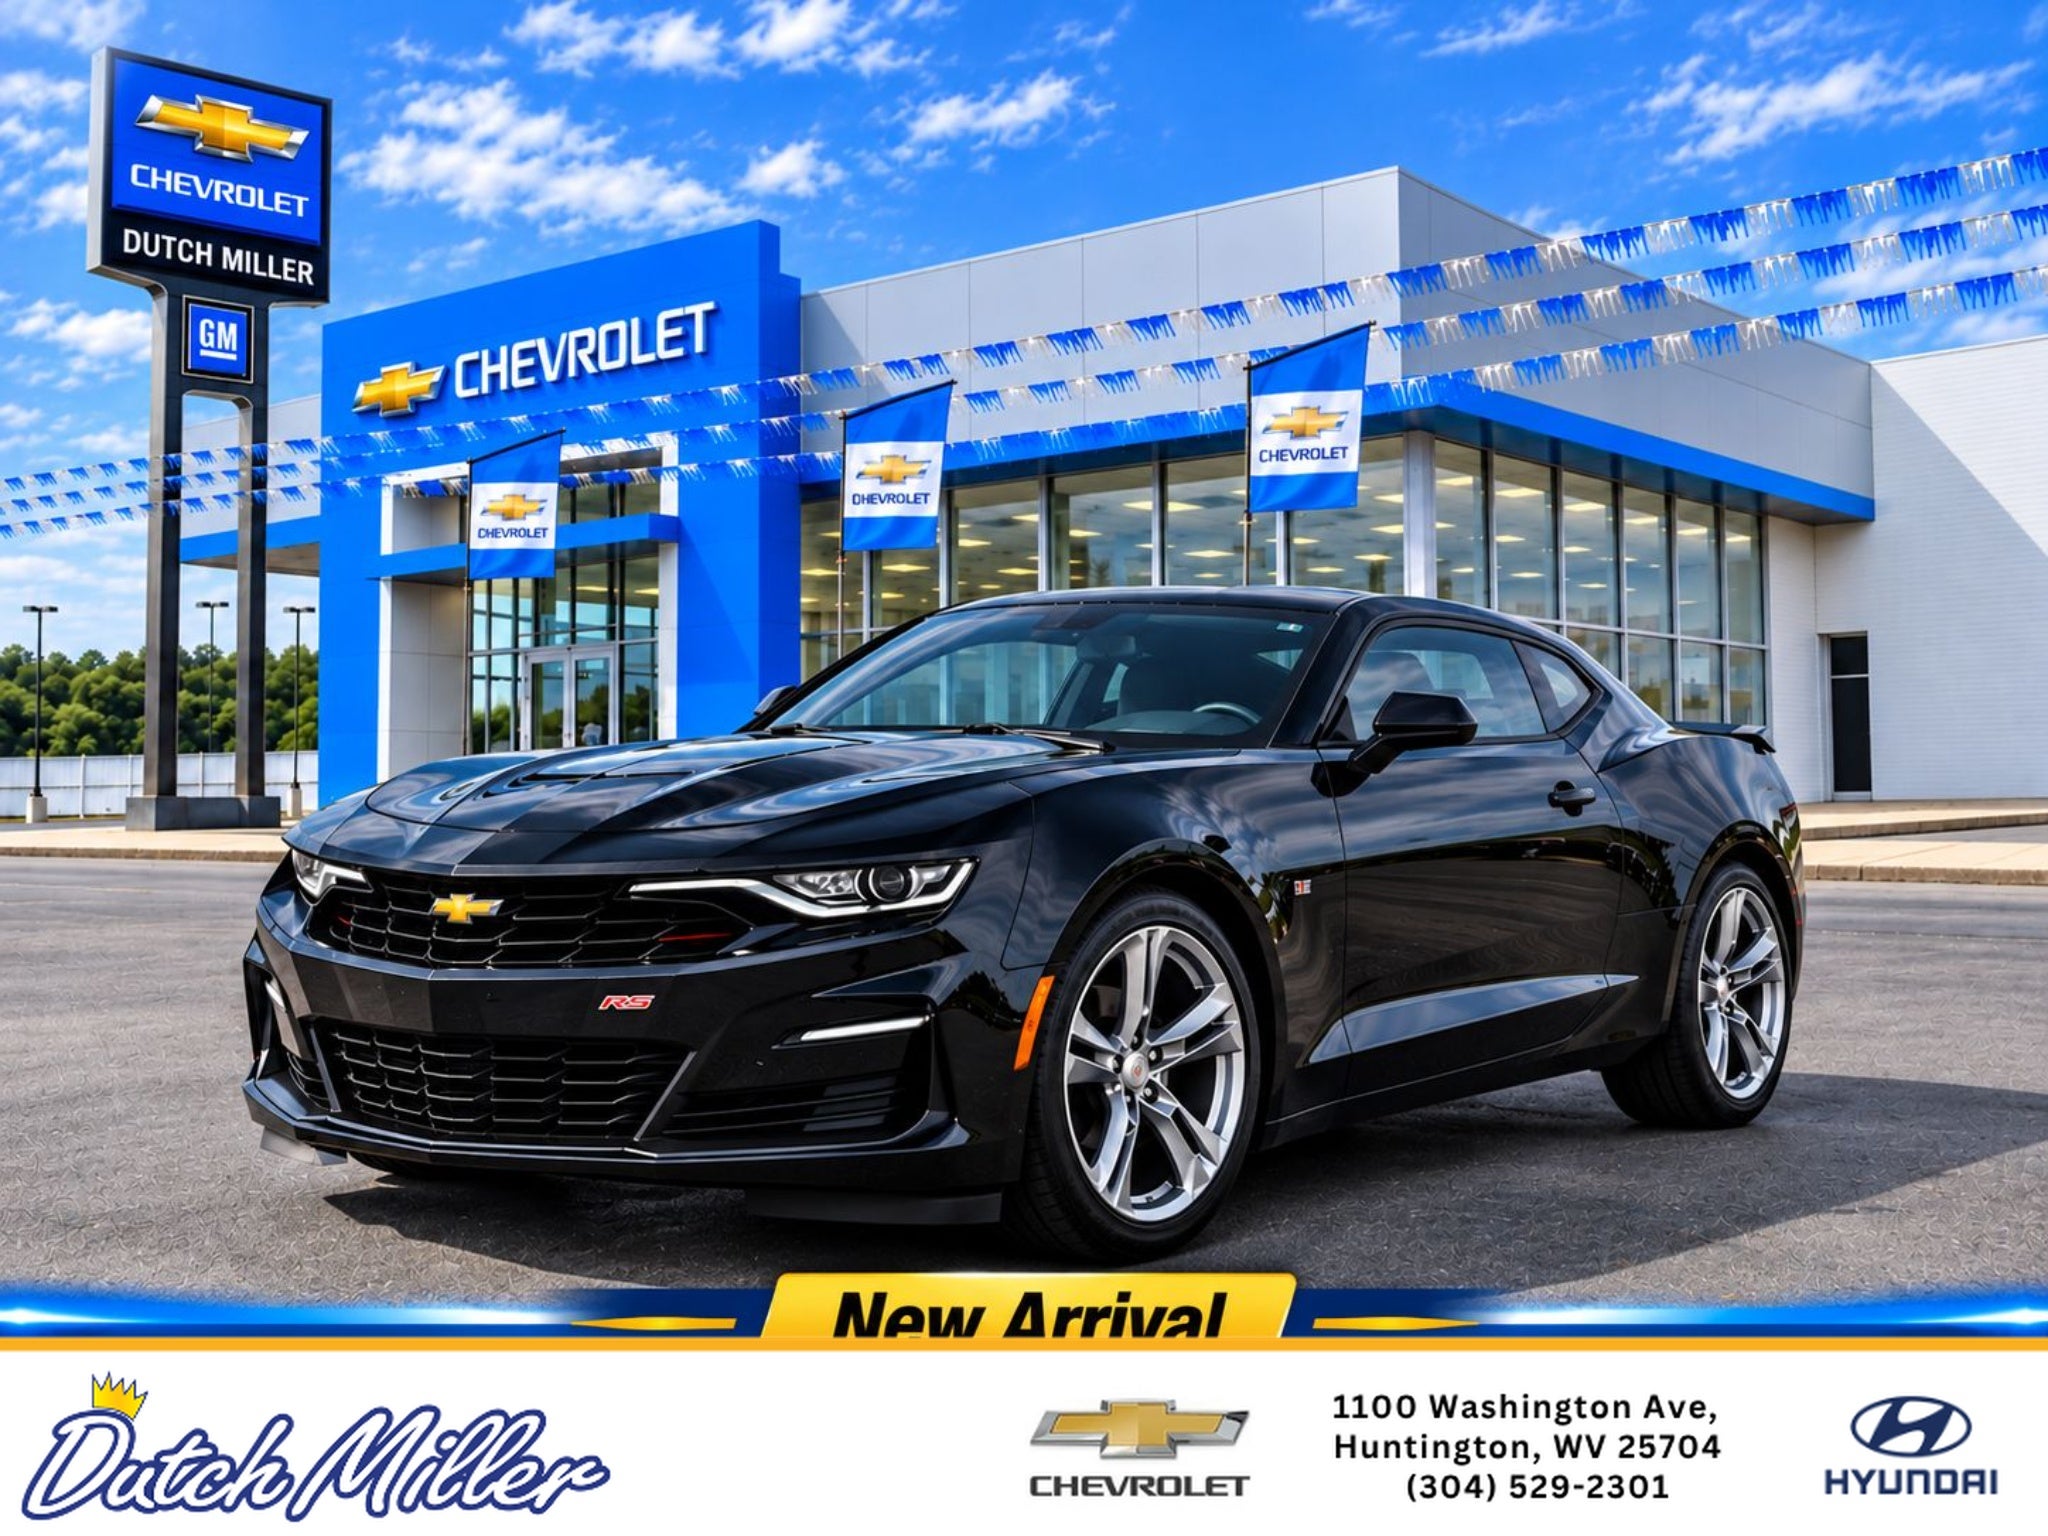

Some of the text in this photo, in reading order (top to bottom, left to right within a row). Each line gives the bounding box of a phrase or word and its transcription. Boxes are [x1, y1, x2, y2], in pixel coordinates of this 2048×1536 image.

[130, 163, 310, 218] CHEVROLET
[123, 228, 315, 286] DUTCH MILLER
[199, 318, 238, 352] GM
[454, 300, 716, 399] CHEVROLET
[1259, 446, 1349, 463] CHEVROLET
[477, 527, 549, 539] CHEVROLET
[598, 994, 655, 1011] RS
